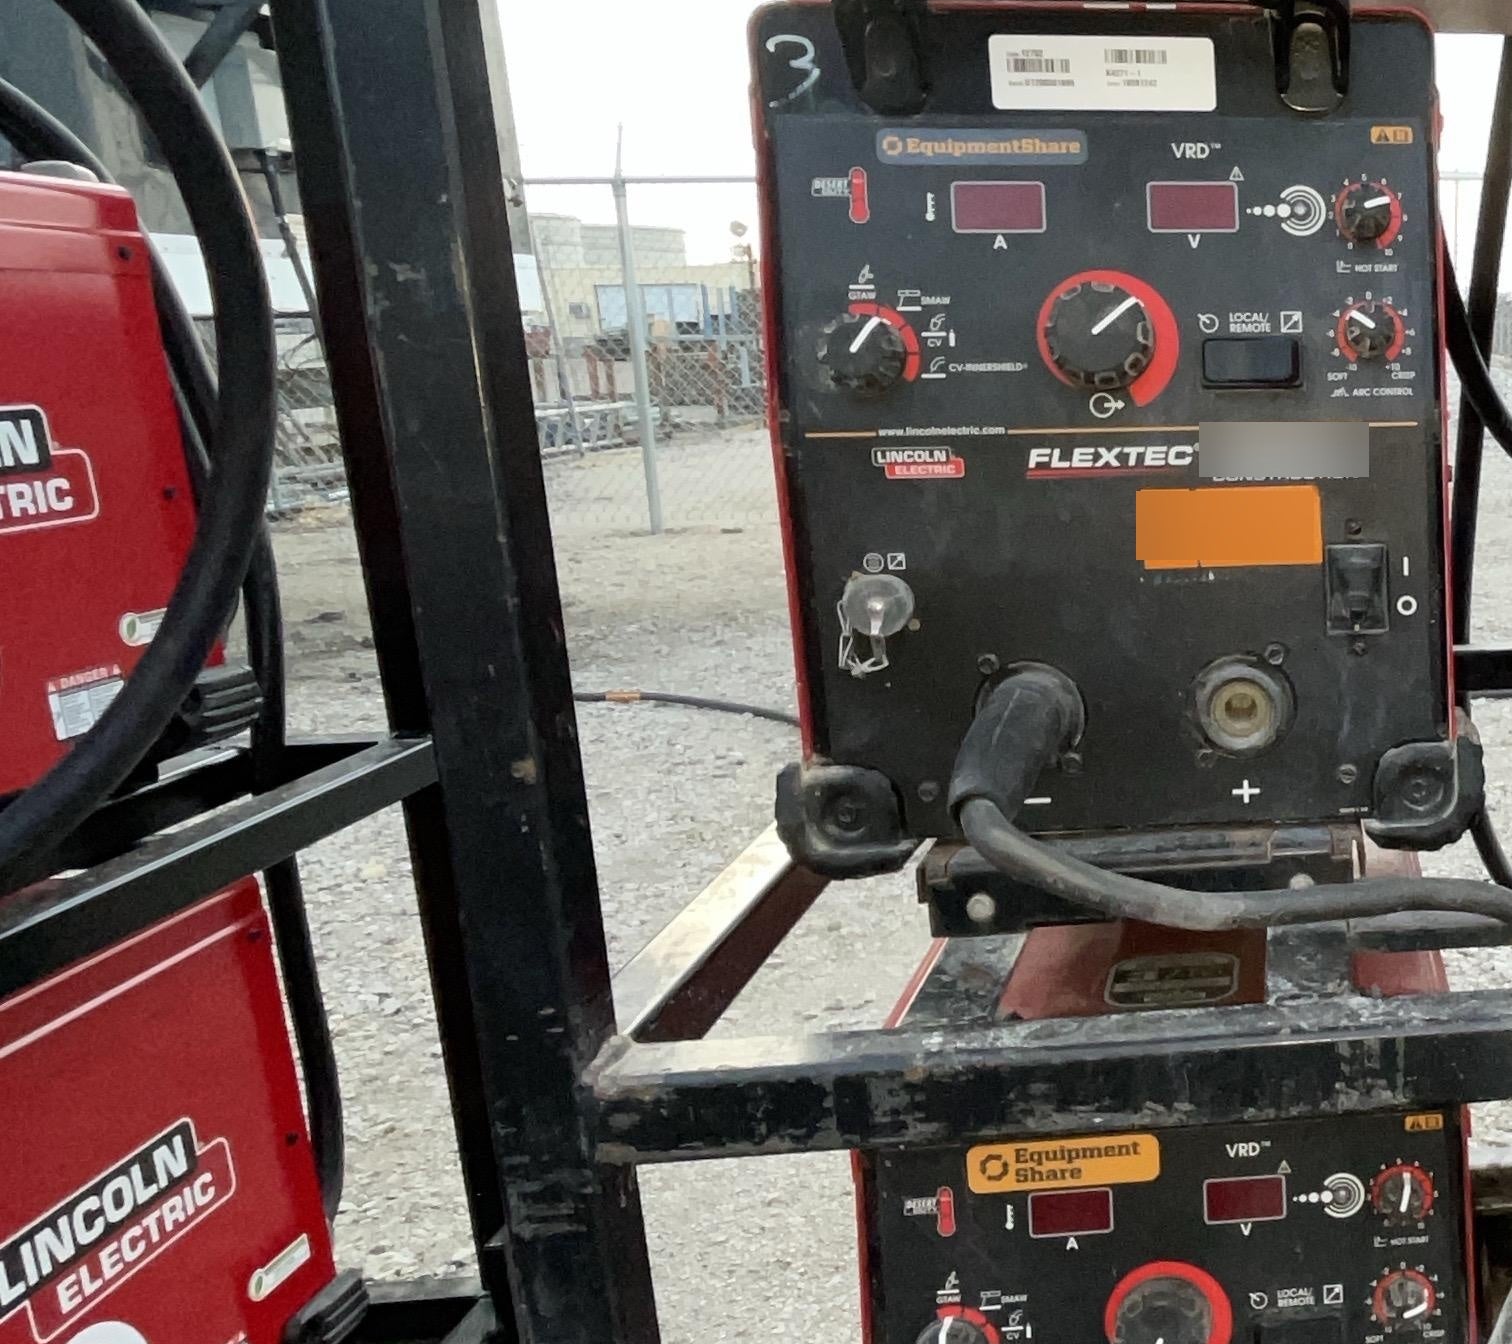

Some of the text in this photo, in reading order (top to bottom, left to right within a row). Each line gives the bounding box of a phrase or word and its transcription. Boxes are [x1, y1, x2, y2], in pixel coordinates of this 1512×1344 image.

[765, 34, 821, 108] 3
[906, 137, 1081, 157] EquipmentShare
[993, 235, 1008, 250] A
[1187, 233, 1201, 249] V
[1229, 312, 1269, 324] LOCAL/
[1229, 323, 1271, 333] REMOTE
[876, 449, 948, 464] LINCOLN
[894, 463, 957, 476] ELECTRIC
[1014, 1141, 1141, 1164] Equipment
[1015, 1166, 1083, 1183] Share
[0, 1135, 189, 1306] LINCOLN
[1240, 1222, 1252, 1236] V
[56, 1172, 216, 1315] ELECTRIC
[1065, 1237, 1079, 1250] A
